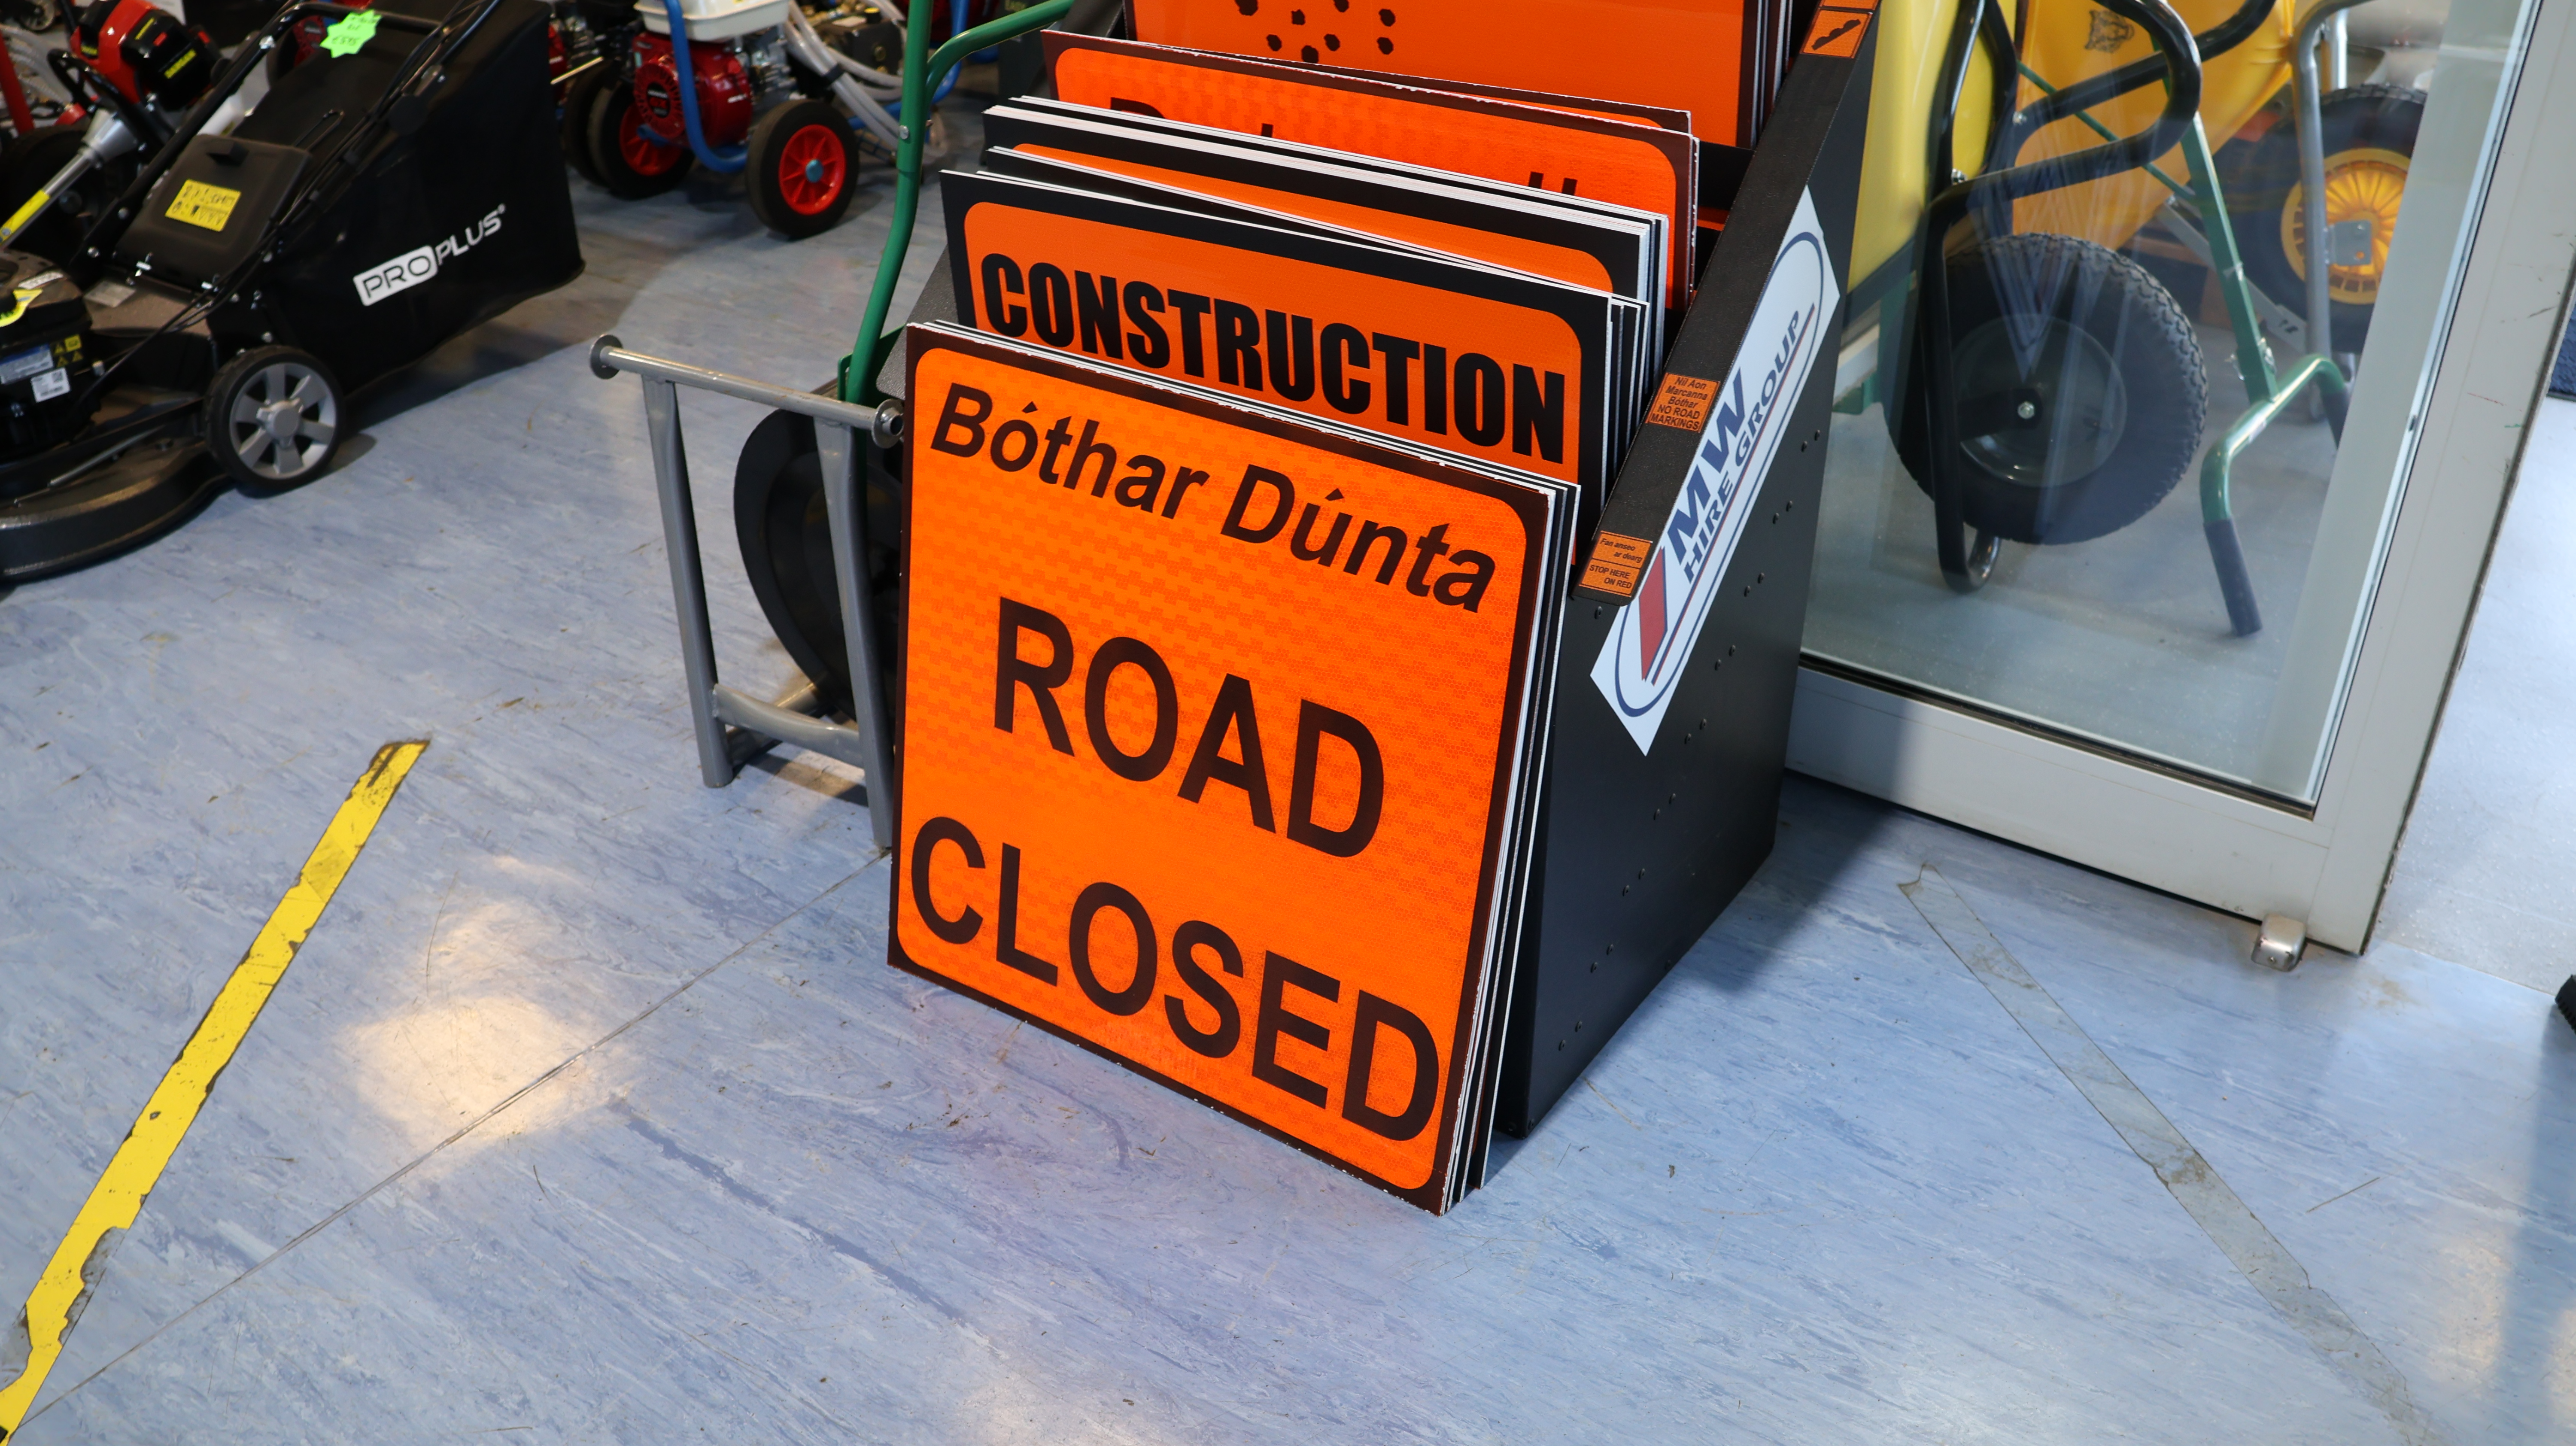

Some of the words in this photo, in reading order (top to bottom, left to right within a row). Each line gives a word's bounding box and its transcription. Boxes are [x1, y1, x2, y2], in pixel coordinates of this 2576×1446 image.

[981, 254, 1564, 464] CONSTRUCTION
[1688, 381, 1707, 389] Aon
[1666, 386, 1708, 400] Marcanna
[1668, 396, 1698, 408] Bóthar
[1657, 404, 1671, 414] NO
[1674, 407, 1700, 419] ROAD
[1651, 413, 1699, 430] MARKINGS
[1684, 470, 1733, 583] HIRE
[1735, 310, 1799, 467] GROUP
[1668, 367, 1745, 565] MW
[931, 383, 1209, 519] Bóthar
[1221, 465, 1495, 612] Dúnta
[1600, 538, 1614, 547] Fan
[1614, 543, 1636, 551] anseo
[1622, 553, 1643, 563] dearg
[1589, 565, 1609, 574] STOP
[1610, 569, 1631, 579] HERE
[1616, 580, 1632, 589] RED
[995, 597, 1383, 857] ROAD
[911, 817, 1439, 1141] CLOSED
